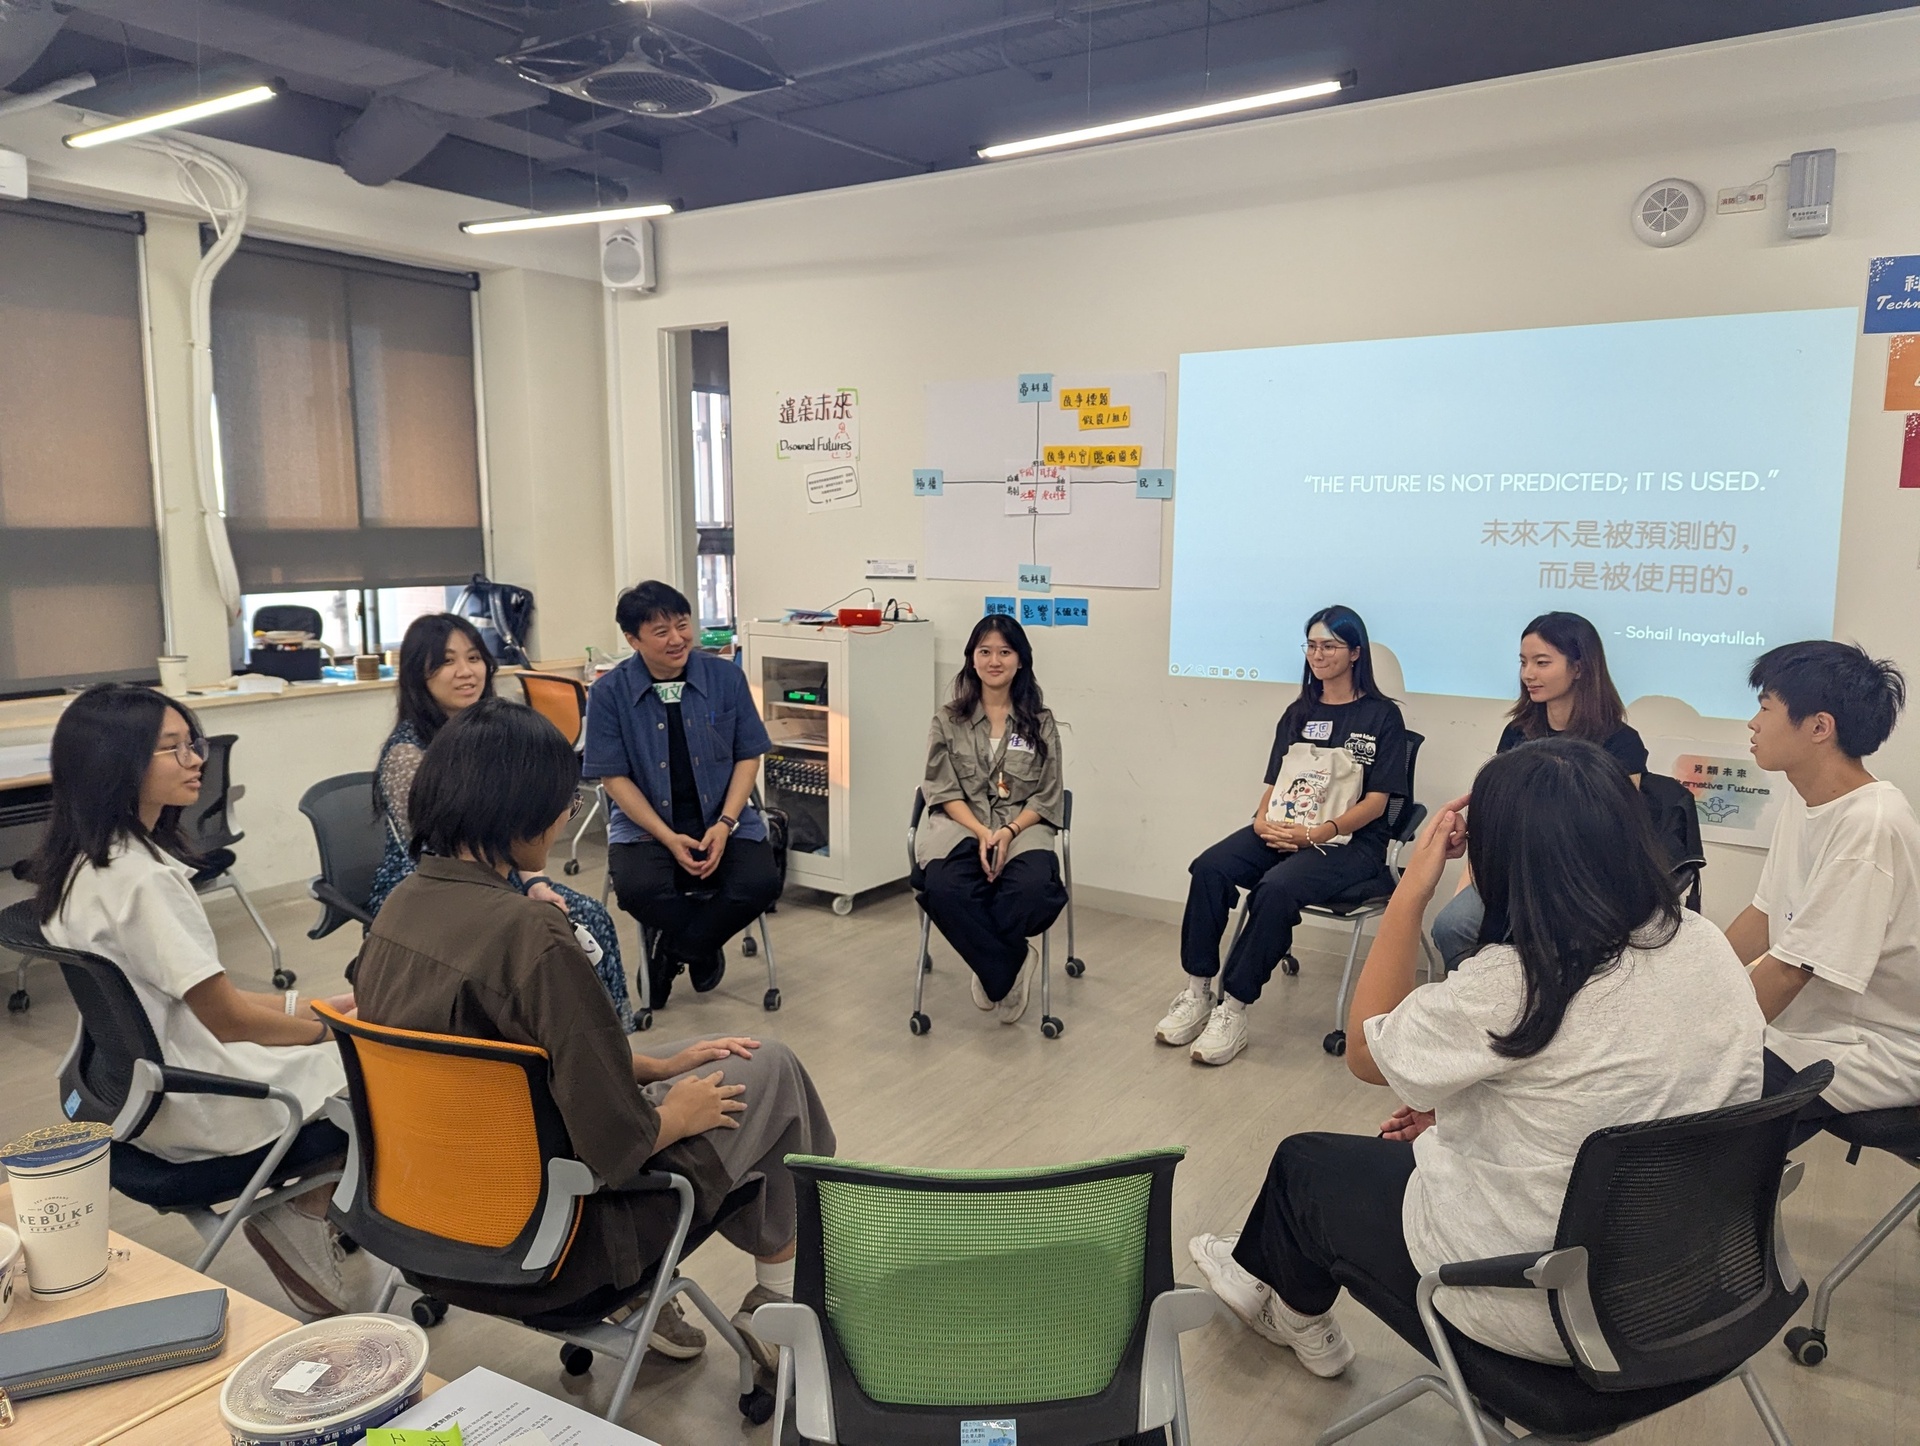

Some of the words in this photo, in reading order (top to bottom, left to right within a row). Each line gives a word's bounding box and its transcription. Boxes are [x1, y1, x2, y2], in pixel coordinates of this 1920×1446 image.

[1748, 193, 1764, 202] 專用
[817, 436, 852, 452] Futures
[1139, 477, 1164, 488] 民主
[1350, 474, 1421, 493] FUTURE
[1427, 474, 1446, 492] IS
[1451, 473, 1495, 492] NOT
[1500, 472, 1629, 494] PREDICTED;
[1636, 471, 1654, 491] IT
[1661, 471, 1683, 491] IS
[1539, 561, 1749, 596] 而是被使用的。
[1023, 604, 1049, 621] 影響
[1625, 625, 1673, 640] Sohail
[1678, 628, 1765, 646] Inayatullah
[1694, 764, 1747, 778] 另類未來
[1727, 783, 1770, 795] Futures
[19, 1202, 94, 1225] KEBUKE
